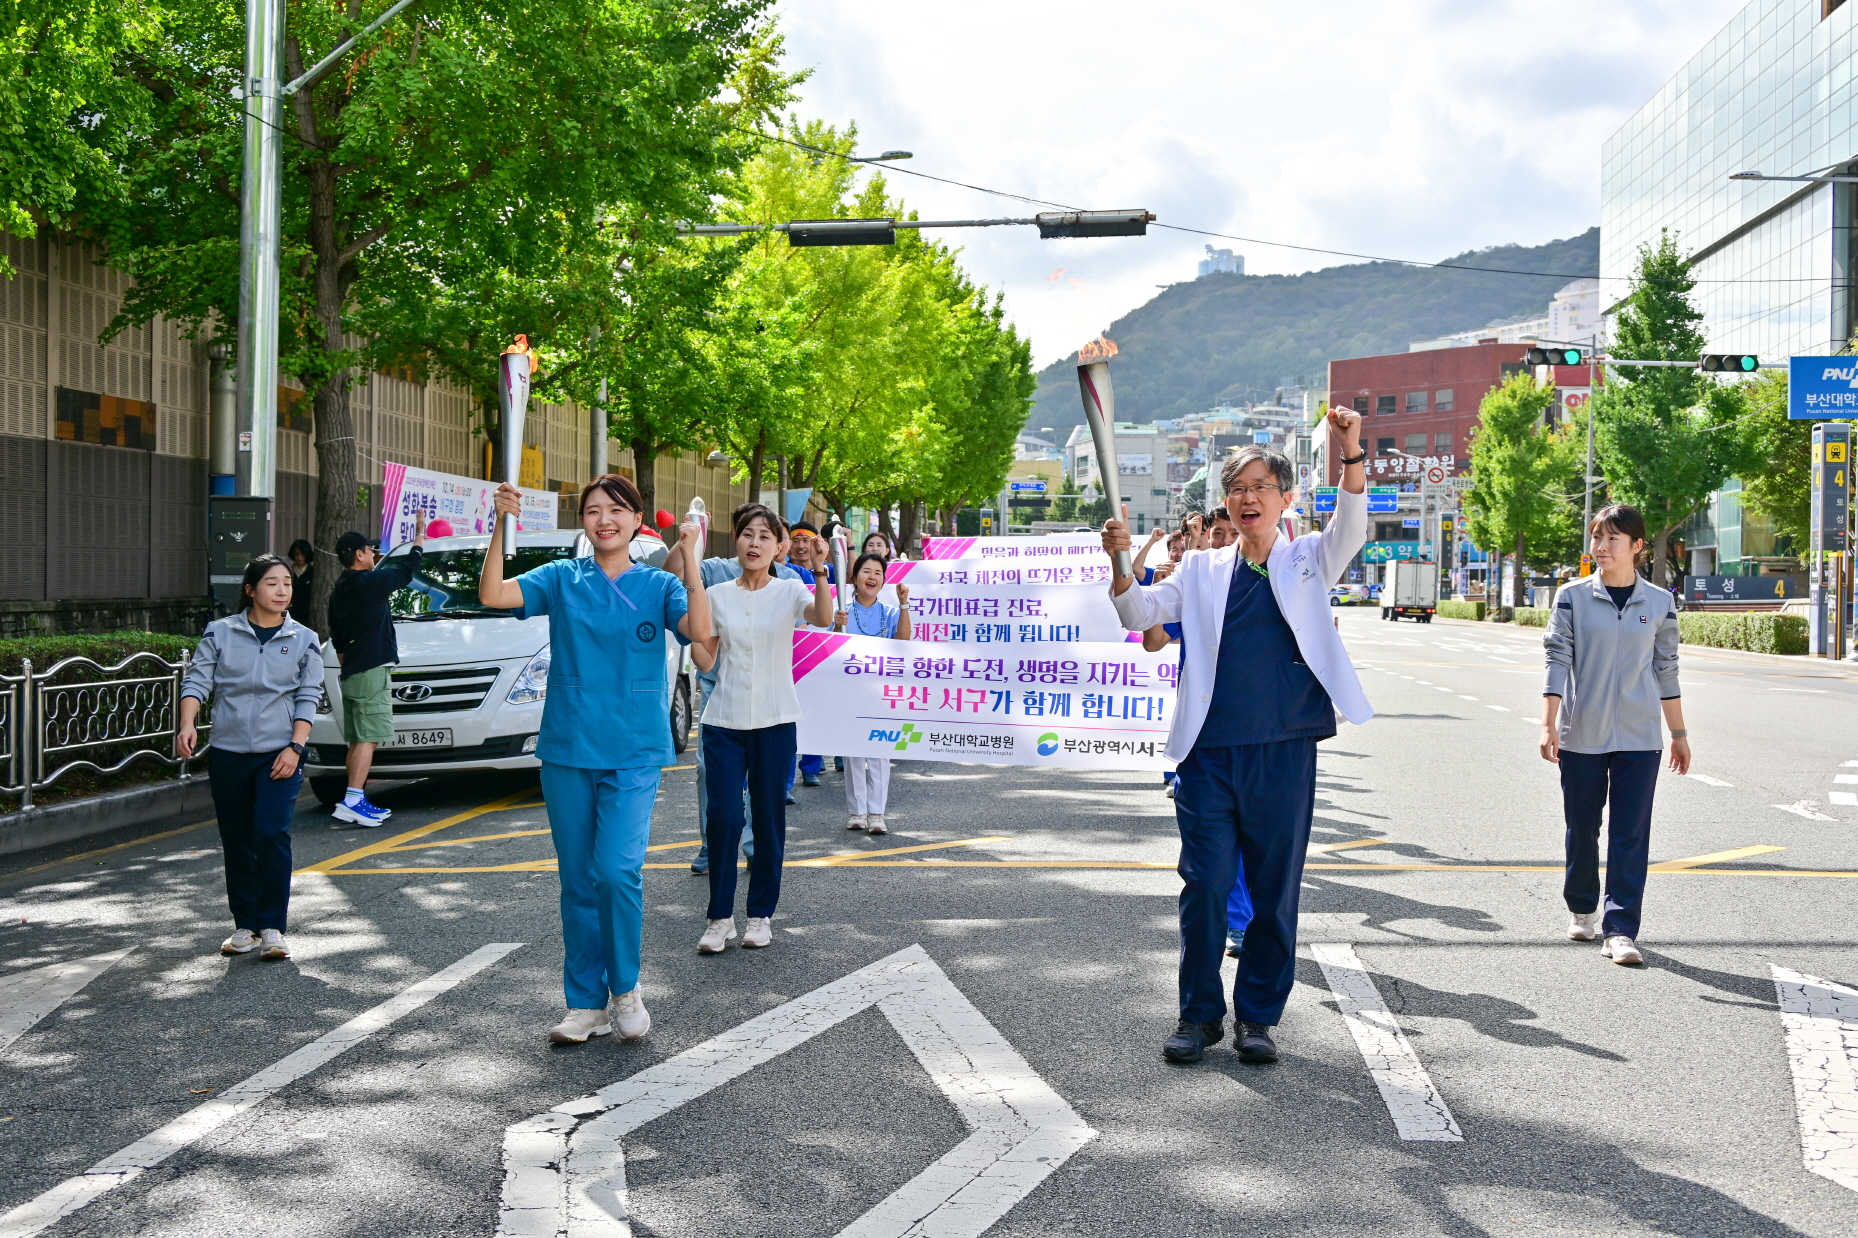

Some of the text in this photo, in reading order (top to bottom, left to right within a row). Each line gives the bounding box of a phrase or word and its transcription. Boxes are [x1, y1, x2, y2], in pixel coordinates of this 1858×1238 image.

[1805, 392, 1858, 407] 부산대학
[1834, 469, 1845, 487] 4
[1446, 533, 1452, 541] 6
[975, 569, 1021, 585] 체전의
[1027, 567, 1074, 584] 뜨거운
[1080, 565, 1111, 582] 불꽃
[1706, 592, 1724, 600] Toseong
[1774, 579, 1785, 598] 4
[908, 597, 1048, 619] 국가대표급 진료,
[974, 623, 1011, 643] 함께
[1018, 624, 1081, 643] 뜁니다!
[842, 653, 906, 678] 승리를
[912, 657, 957, 680] 향한
[961, 658, 1009, 683] 도전,
[1015, 659, 1080, 685] 생명을
[1086, 661, 1151, 688] 지키는
[881, 684, 1165, 721] 부산 서구가 함께 합니다!
[411, 731, 445, 745] 8649
[928, 732, 1015, 750] 부산대학교병원
[966, 748, 992, 756] University
